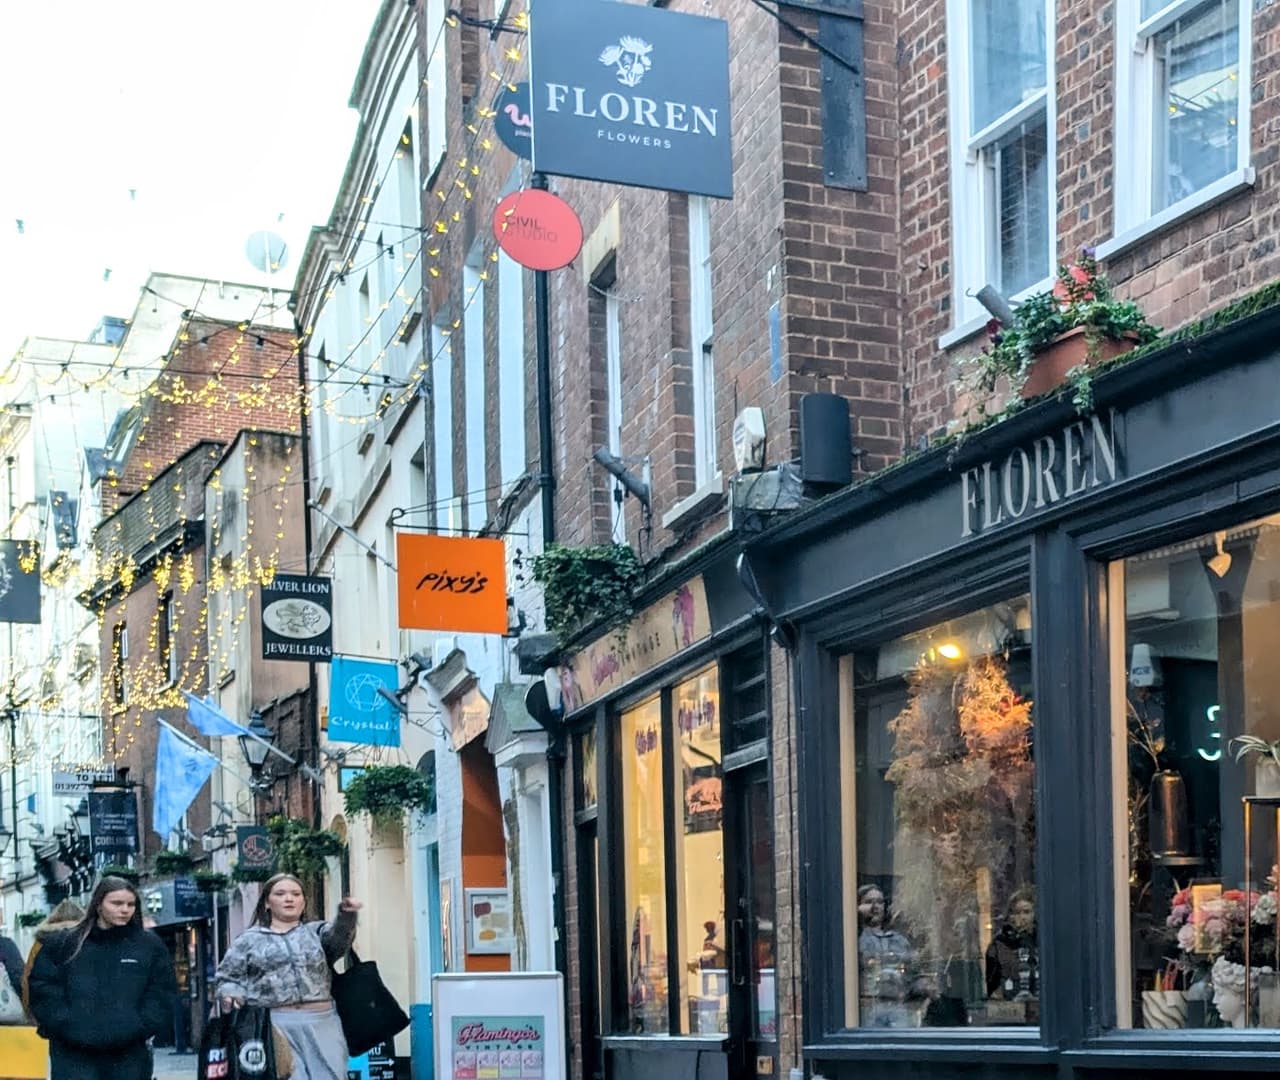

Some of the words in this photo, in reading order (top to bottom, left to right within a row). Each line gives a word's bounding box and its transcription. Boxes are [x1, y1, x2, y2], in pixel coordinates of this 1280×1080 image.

[545, 82, 718, 137] FLOREN
[597, 129, 672, 149] FLOWERS
[960, 407, 1117, 538] FLOREN
[301, 581, 330, 594] LION
[265, 642, 332, 656] JEWELLERS
